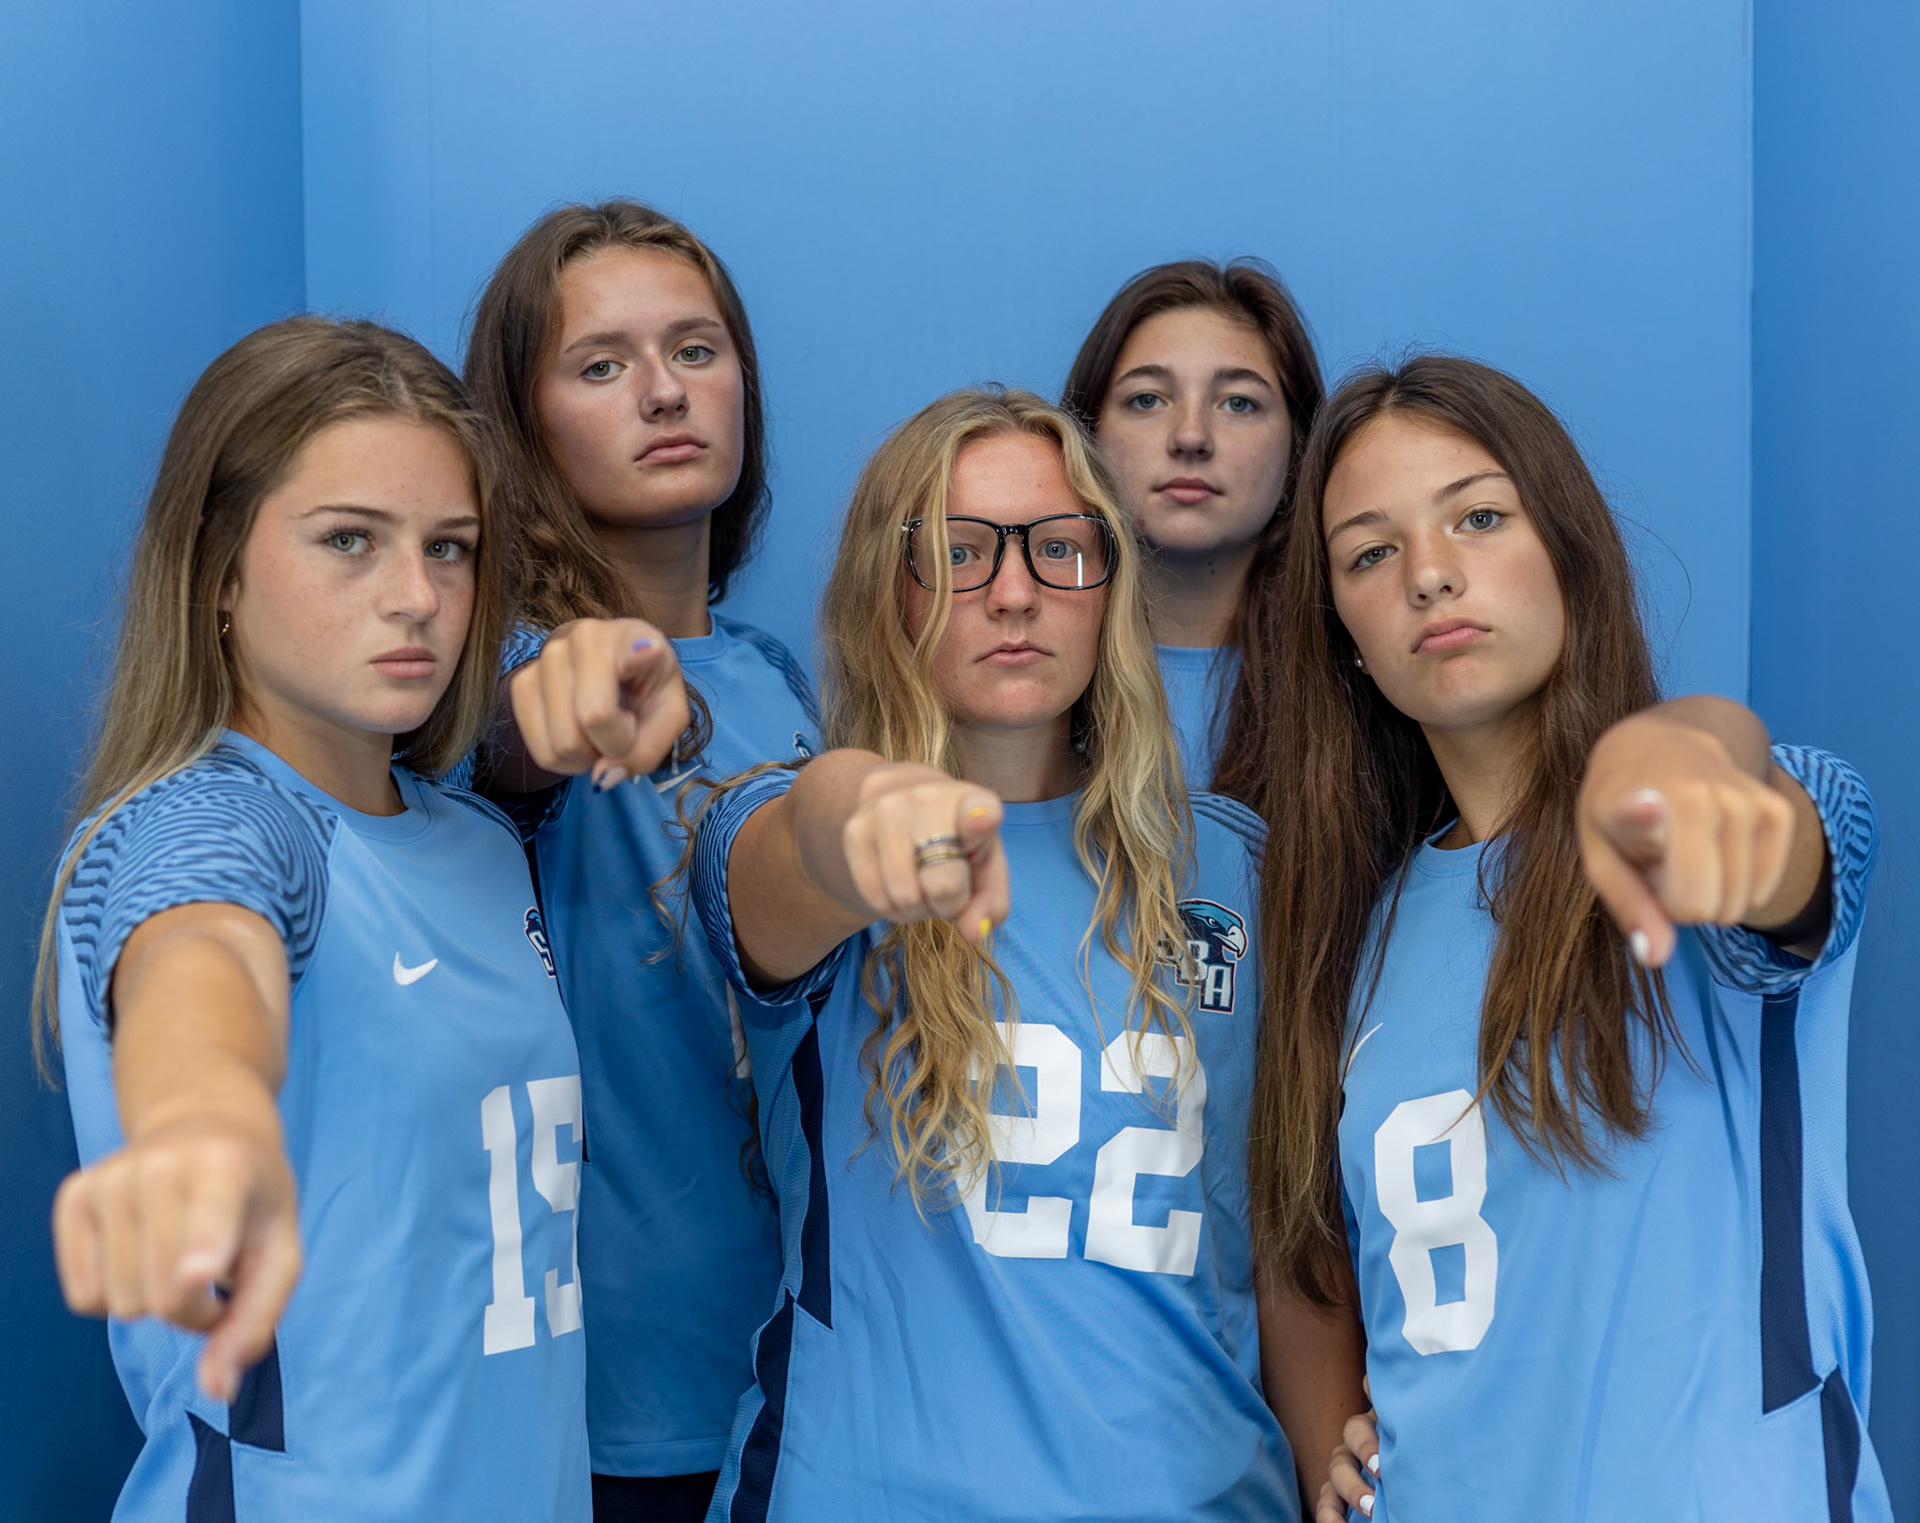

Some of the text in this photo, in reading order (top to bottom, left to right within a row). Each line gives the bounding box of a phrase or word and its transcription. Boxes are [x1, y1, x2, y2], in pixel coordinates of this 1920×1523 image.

[481, 1075, 583, 1356] 15
[946, 1021, 1207, 1276] 22
[1374, 1089, 1498, 1356] 8
